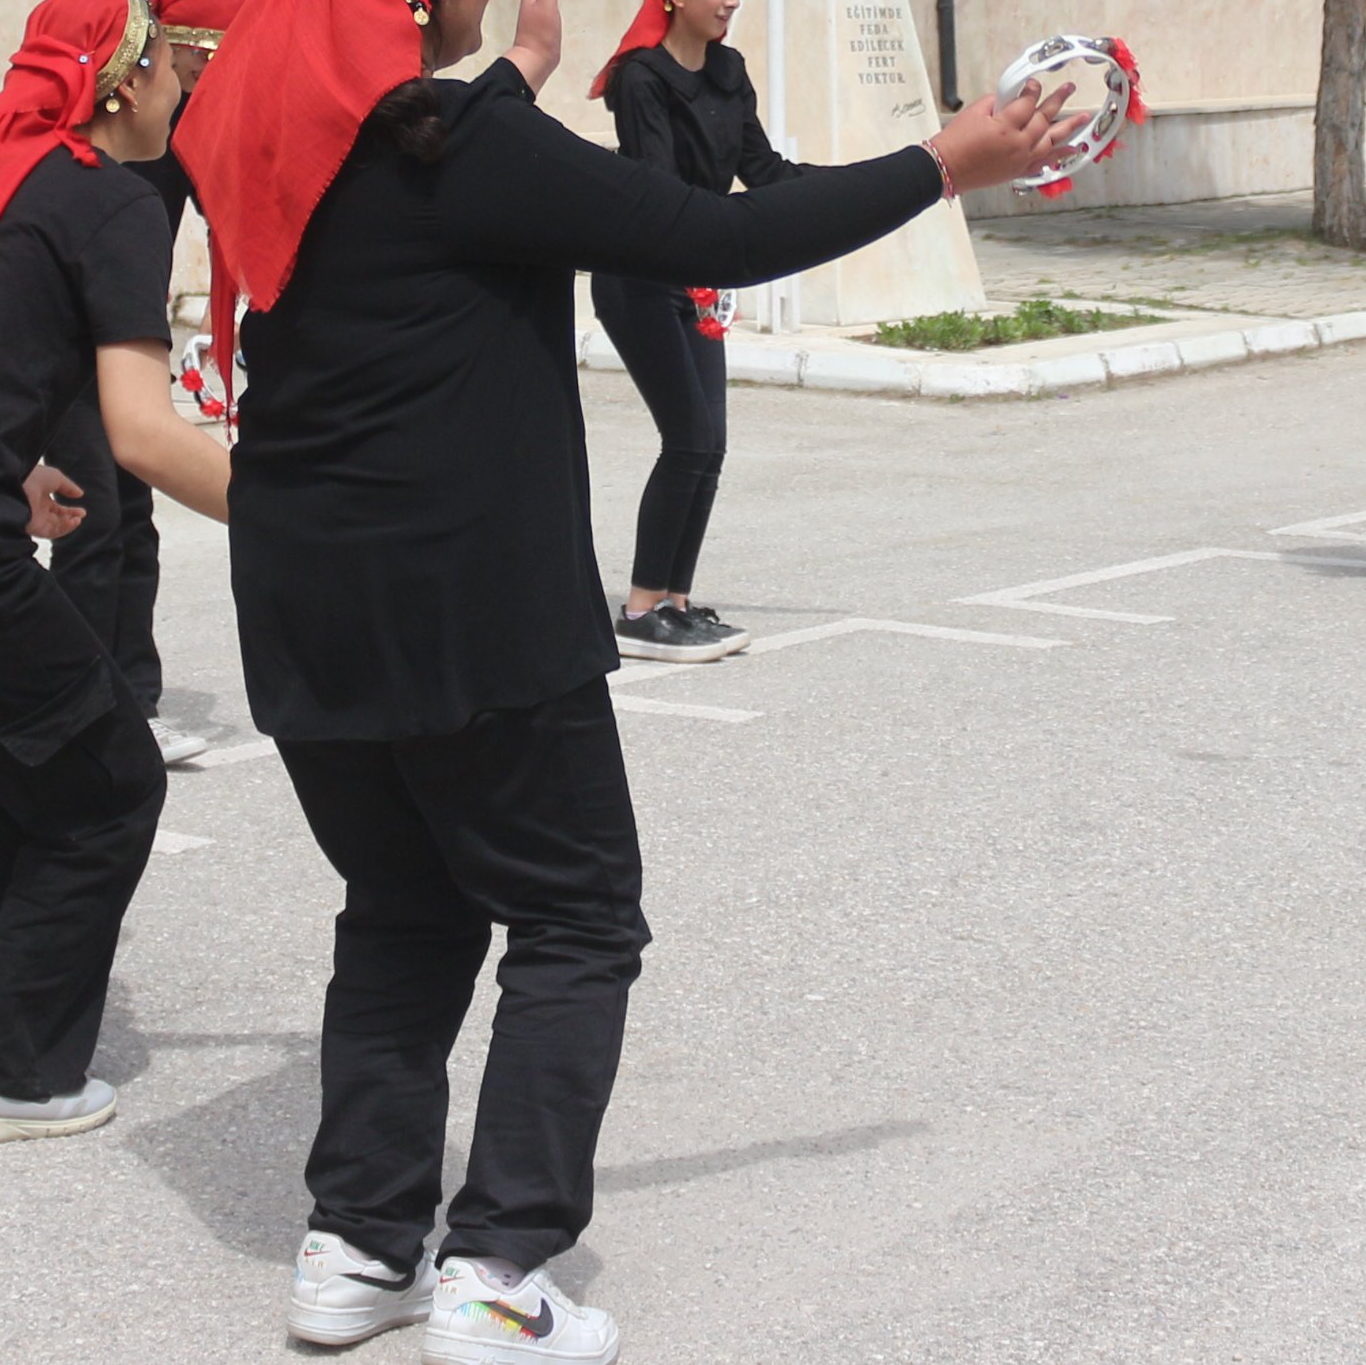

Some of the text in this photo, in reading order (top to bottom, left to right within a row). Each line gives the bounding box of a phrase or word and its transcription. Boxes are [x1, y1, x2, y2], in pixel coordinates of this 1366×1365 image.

[859, 24, 890, 36] FEDA
[867, 56, 896, 68] FERT
[857, 73, 907, 85] YOKTUR
